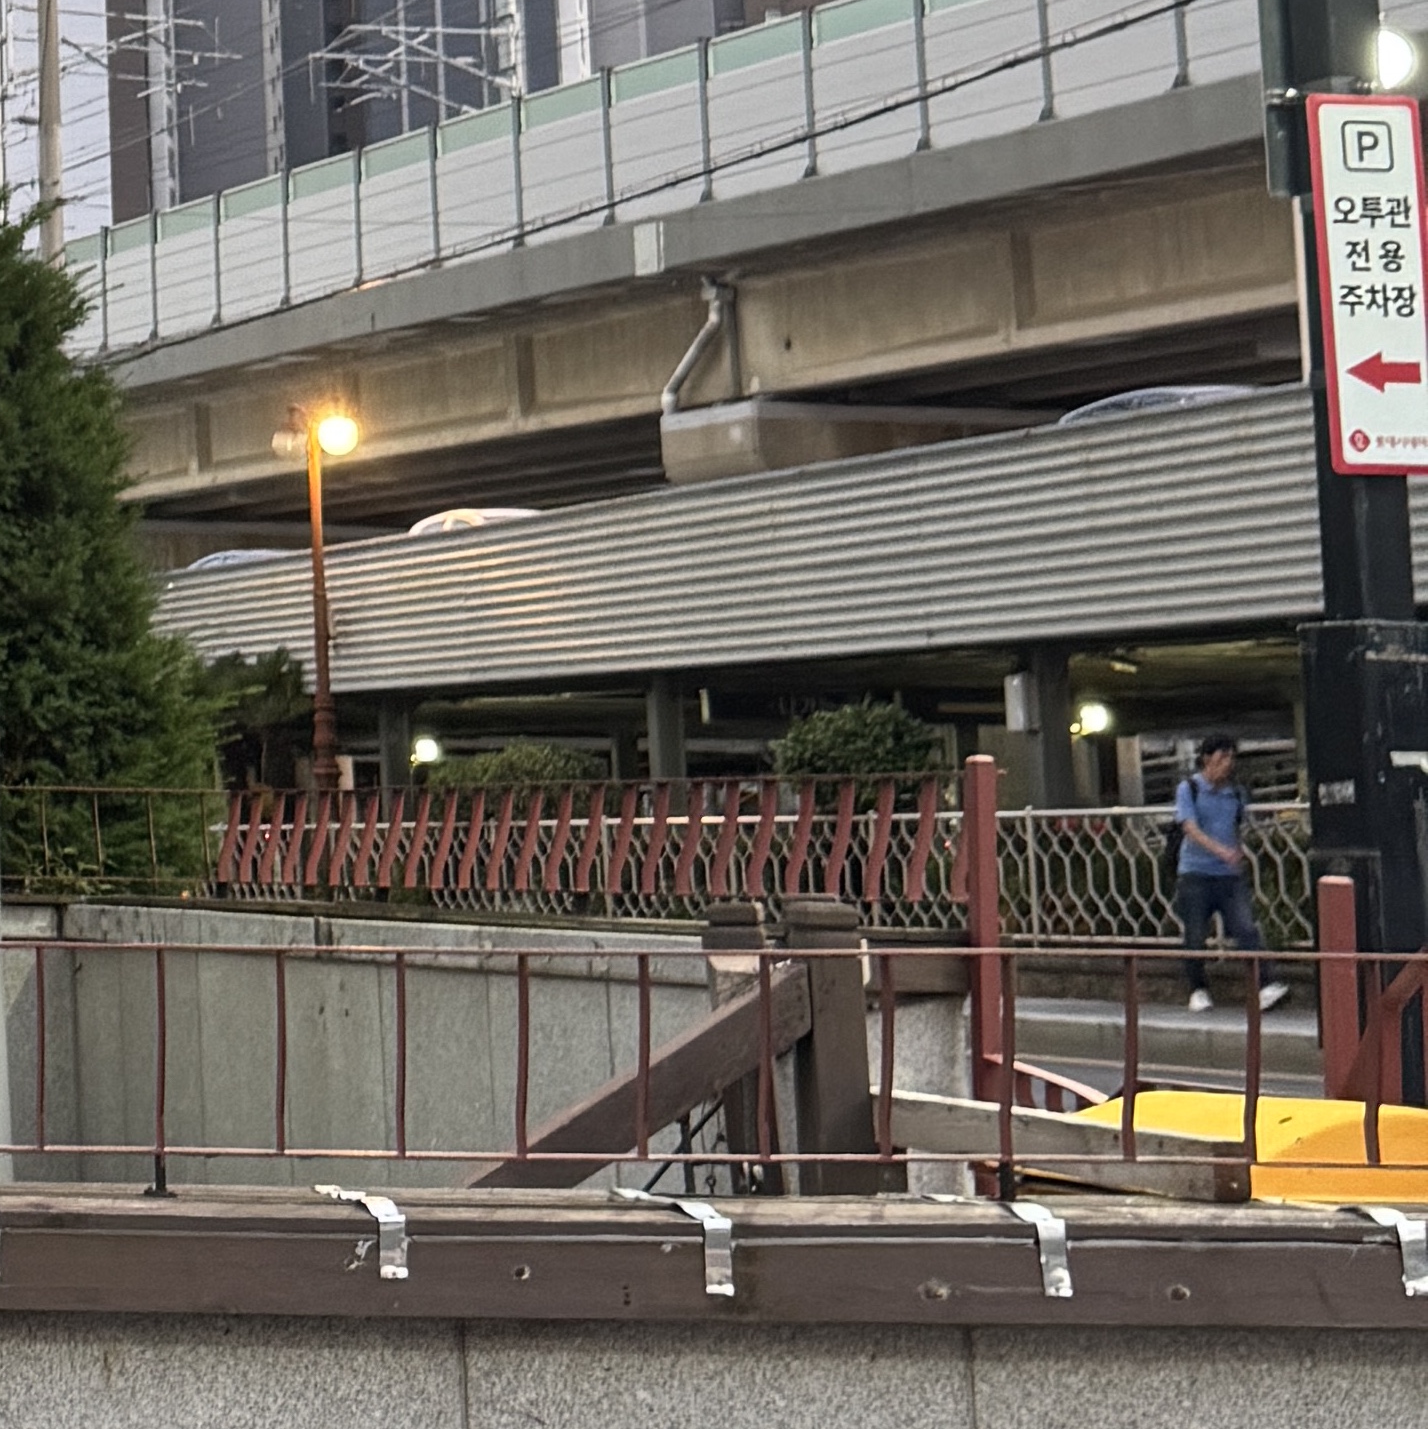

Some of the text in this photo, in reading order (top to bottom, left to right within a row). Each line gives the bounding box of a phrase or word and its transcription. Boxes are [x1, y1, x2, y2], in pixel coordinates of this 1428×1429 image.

[1356, 130, 1379, 162] P
[1332, 195, 1412, 229] 오투관
[1338, 282, 1416, 318] 주차장
